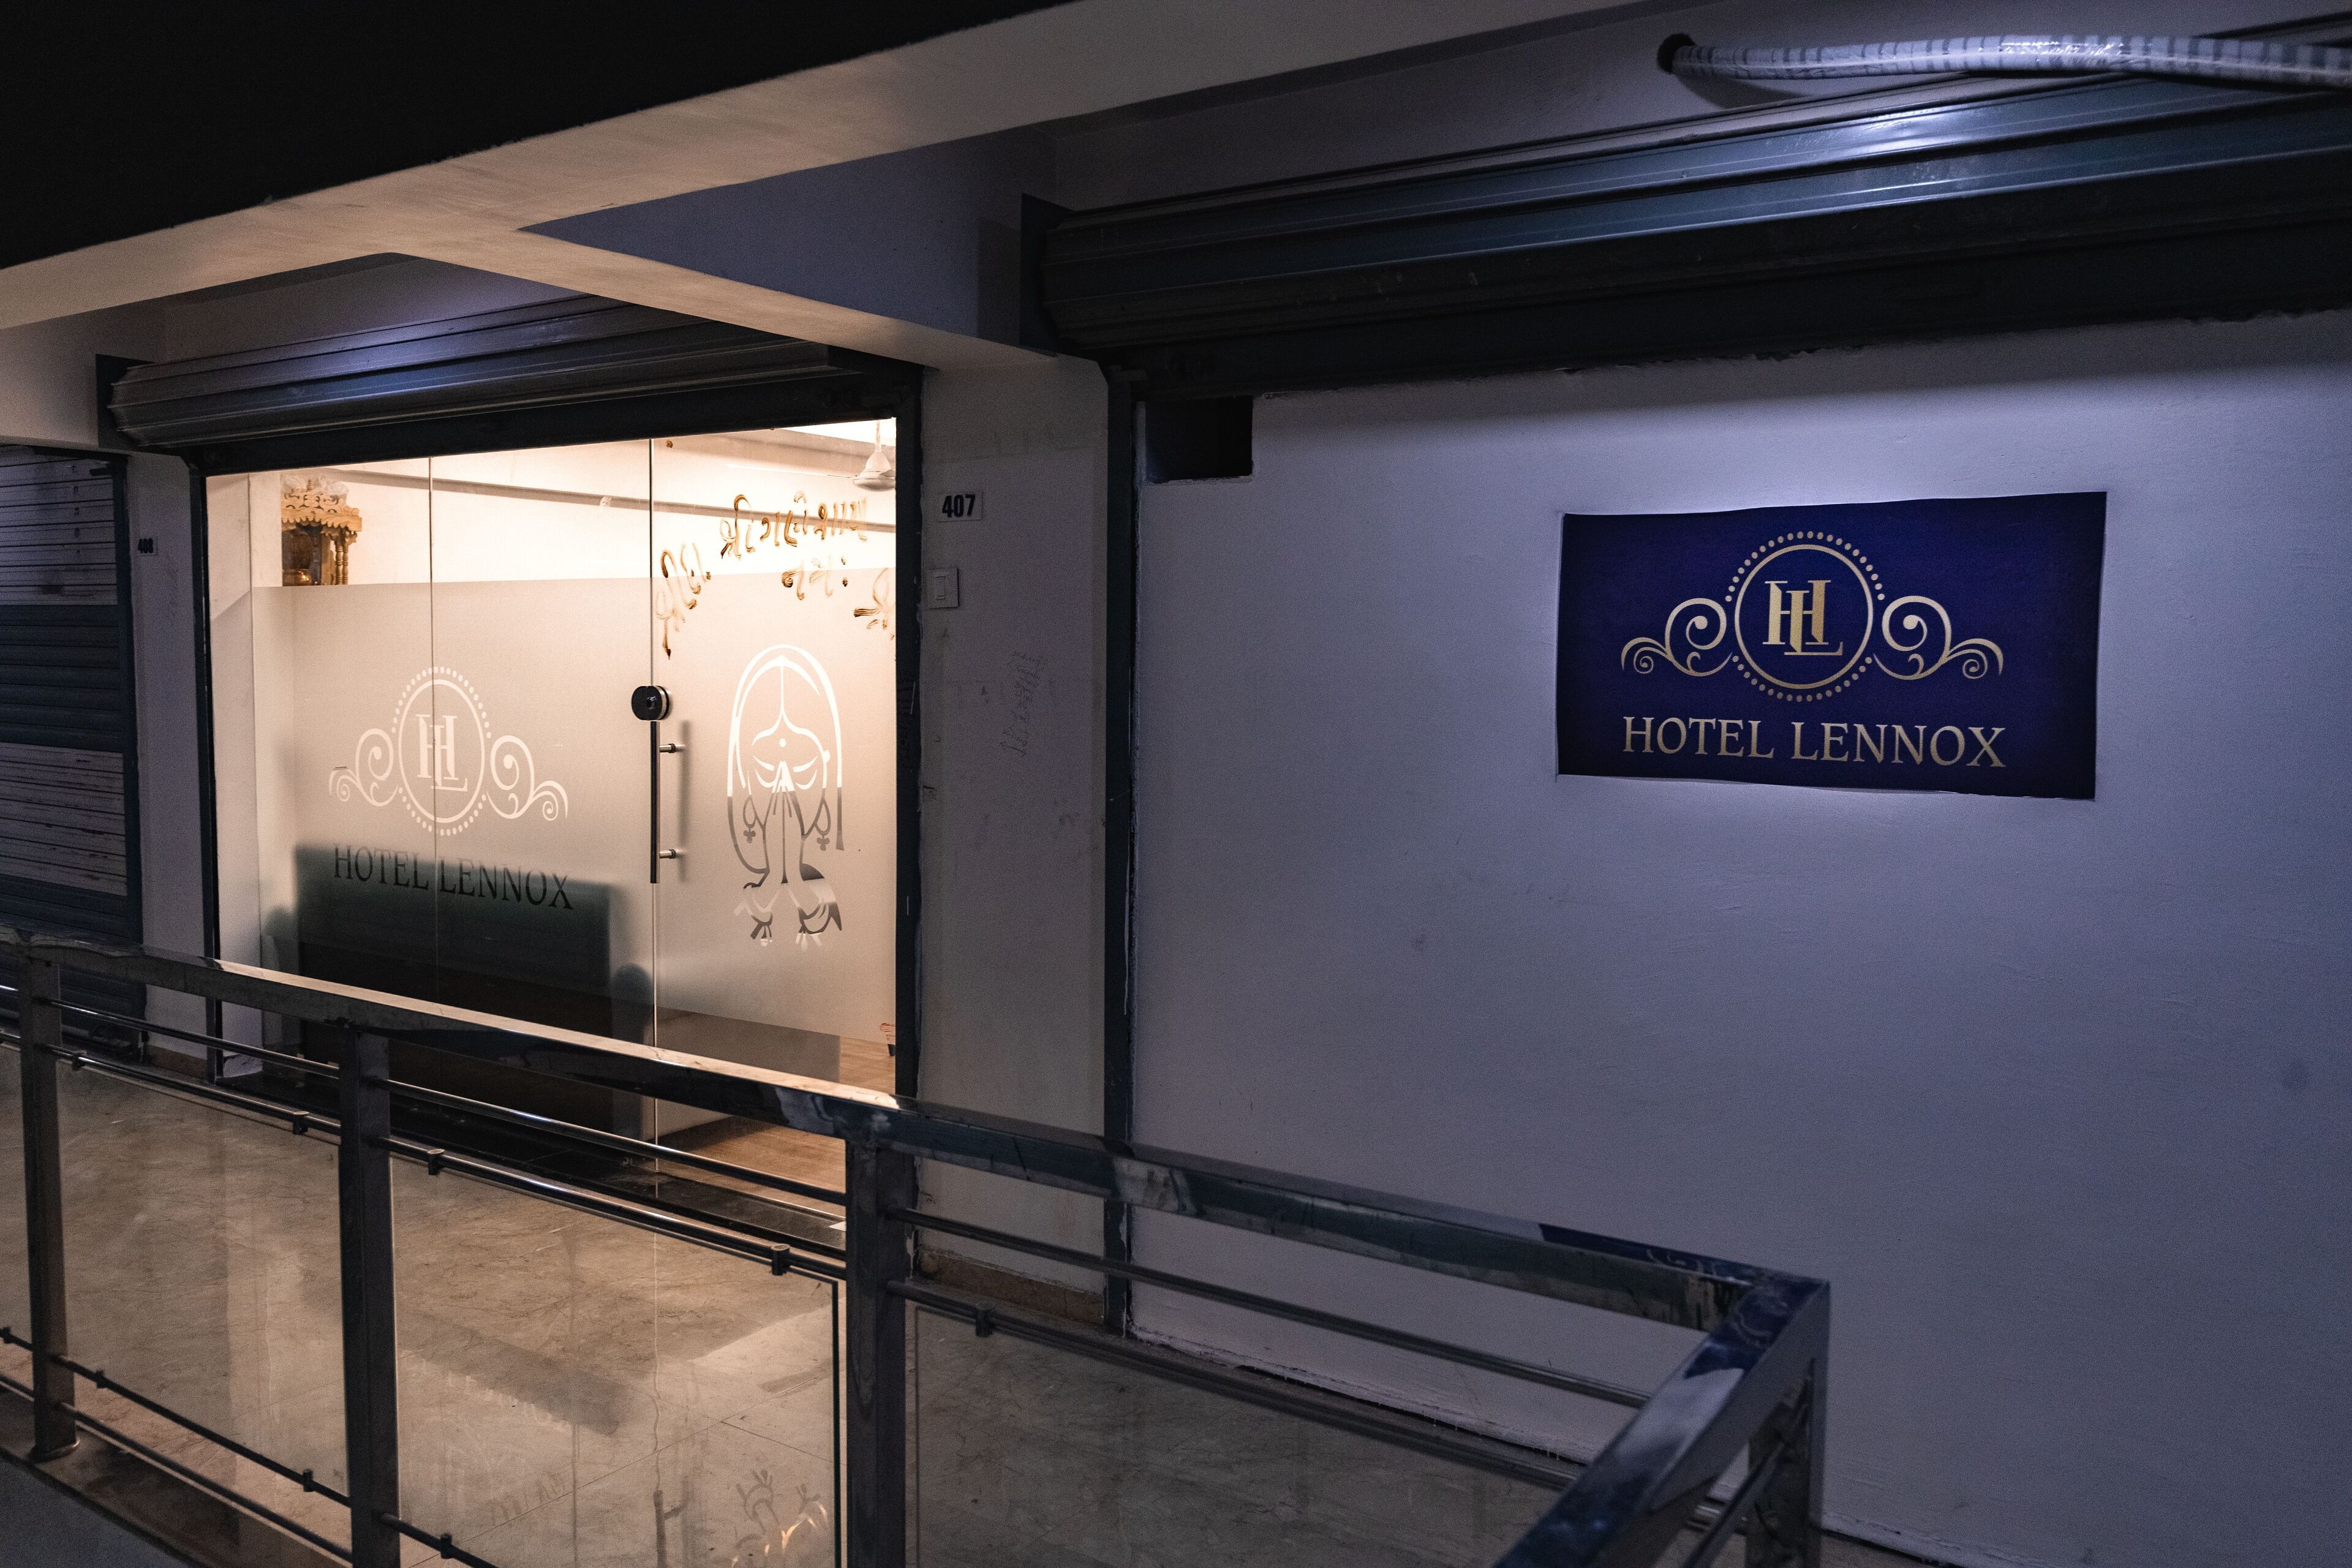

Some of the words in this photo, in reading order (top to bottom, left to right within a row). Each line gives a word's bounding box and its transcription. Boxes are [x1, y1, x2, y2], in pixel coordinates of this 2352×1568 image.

[941, 494, 976, 518] 407
[1622, 715, 1774, 760] HOTEL
[1790, 721, 2007, 769] LENNOX
[333, 843, 429, 891] HOTEL
[439, 856, 574, 910] LENNOX
